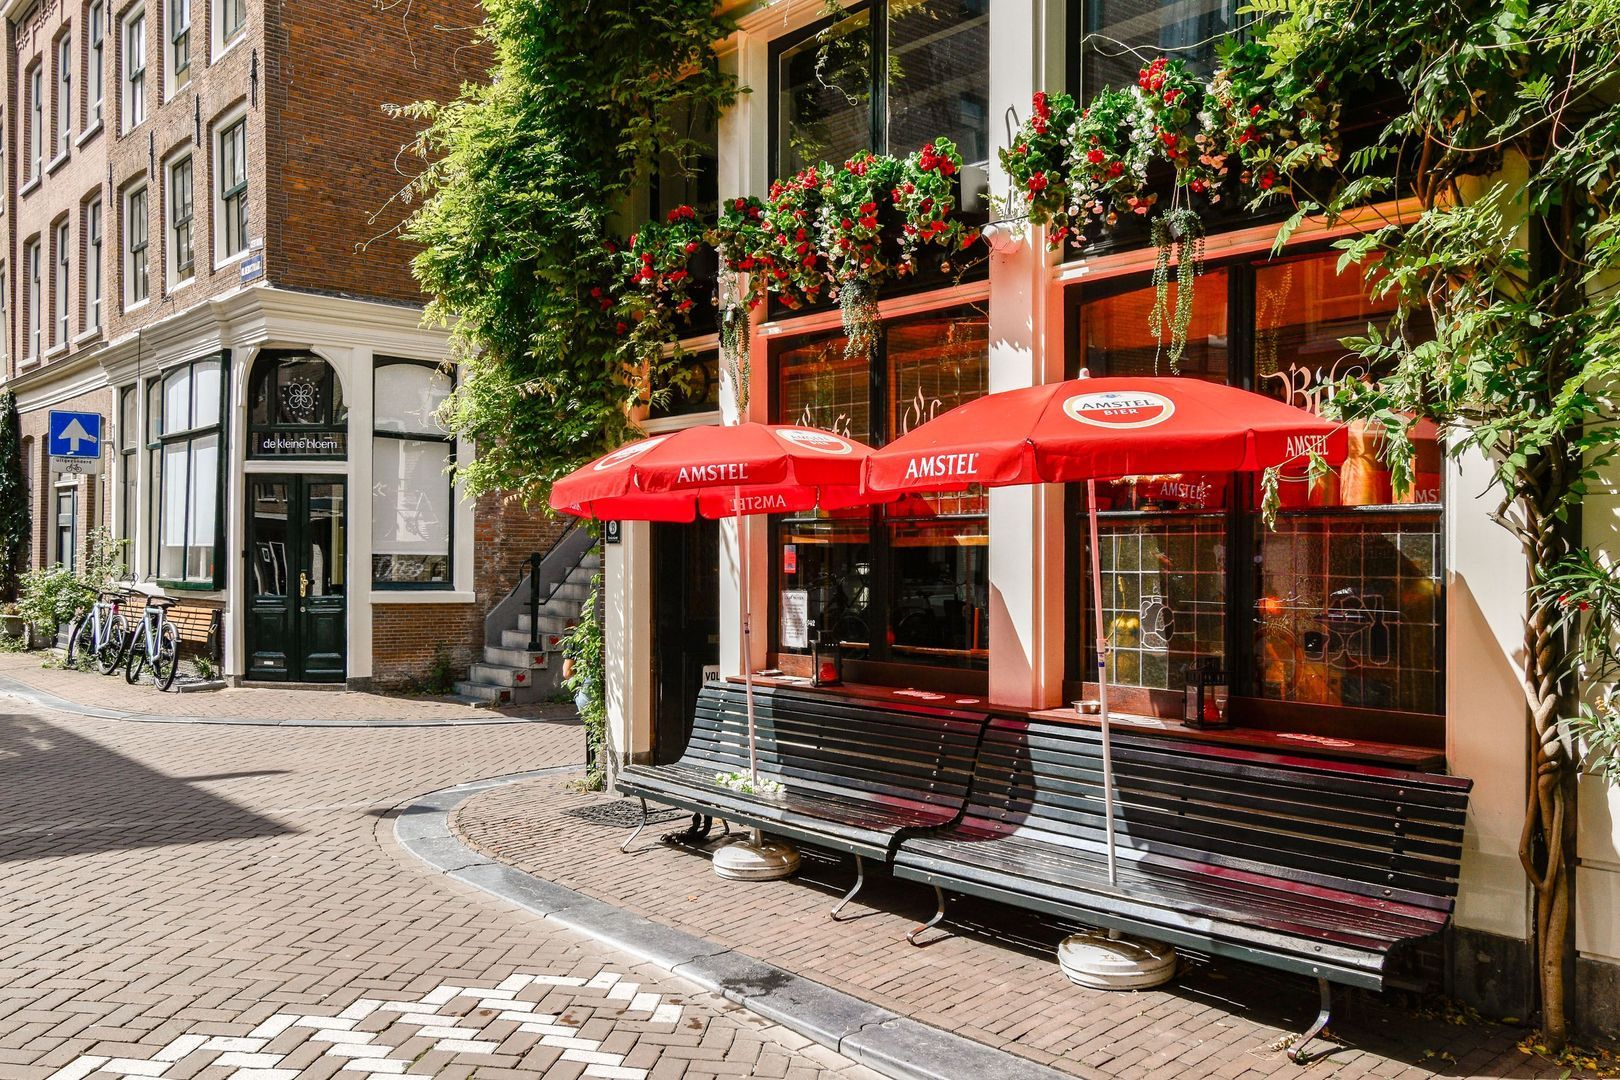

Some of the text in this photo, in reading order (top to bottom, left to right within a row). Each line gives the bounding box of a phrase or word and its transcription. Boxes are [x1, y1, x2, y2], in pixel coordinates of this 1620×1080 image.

[1082, 399, 1155, 410] AMSTEL
[1103, 408, 1139, 416] BIER
[263, 438, 338, 449] de kleine bloem
[1285, 434, 1329, 458] AMSTEL
[677, 463, 749, 484] AMSTEL
[904, 453, 978, 479] AMSTEL
[1160, 481, 1202, 500] AMSTEL
